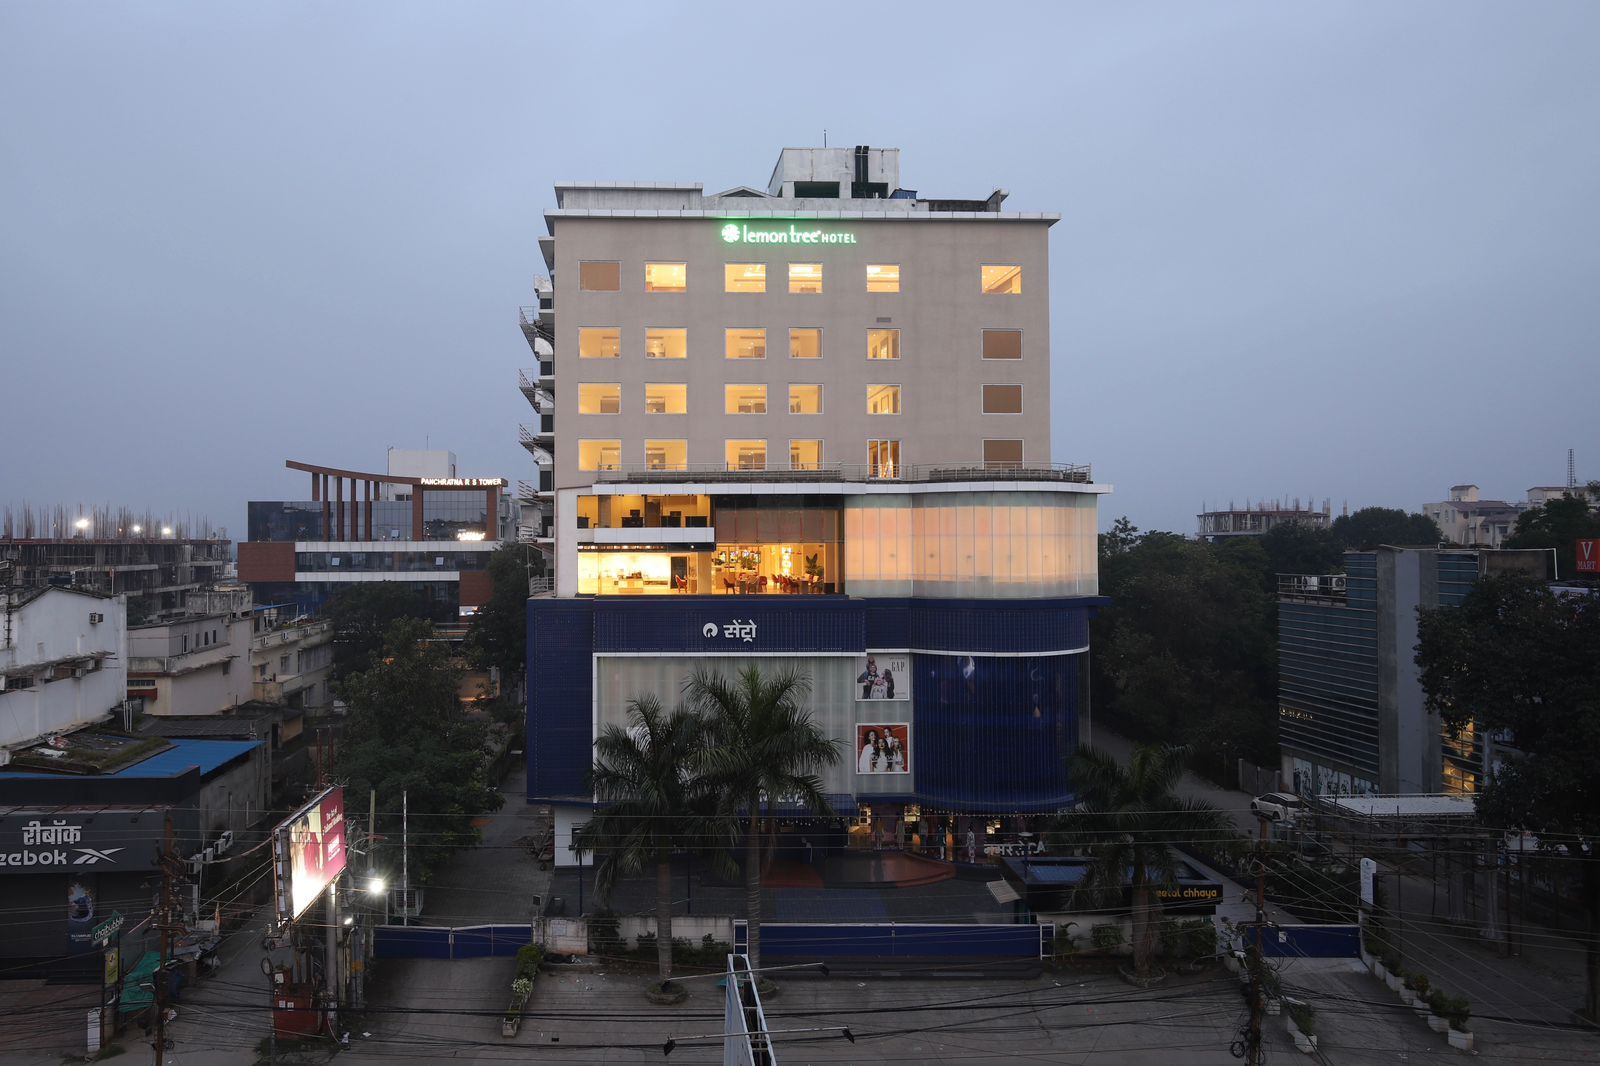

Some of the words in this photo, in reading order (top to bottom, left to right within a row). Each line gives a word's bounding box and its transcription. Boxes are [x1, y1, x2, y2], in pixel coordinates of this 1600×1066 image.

[743, 224, 787, 243] lemon
[789, 224, 821, 243] tree
[822, 233, 857, 243] HOTEL
[421, 477, 463, 486] PANCHRATNA
[479, 477, 502, 485] TOWER
[1580, 541, 1593, 561] V
[1577, 561, 1596, 570] MART
[723, 618, 757, 643] सेंट्रो
[891, 660, 905, 673] GAP
[21, 819, 82, 845] रीबॉक
[1183, 887, 1217, 899] chhaya
